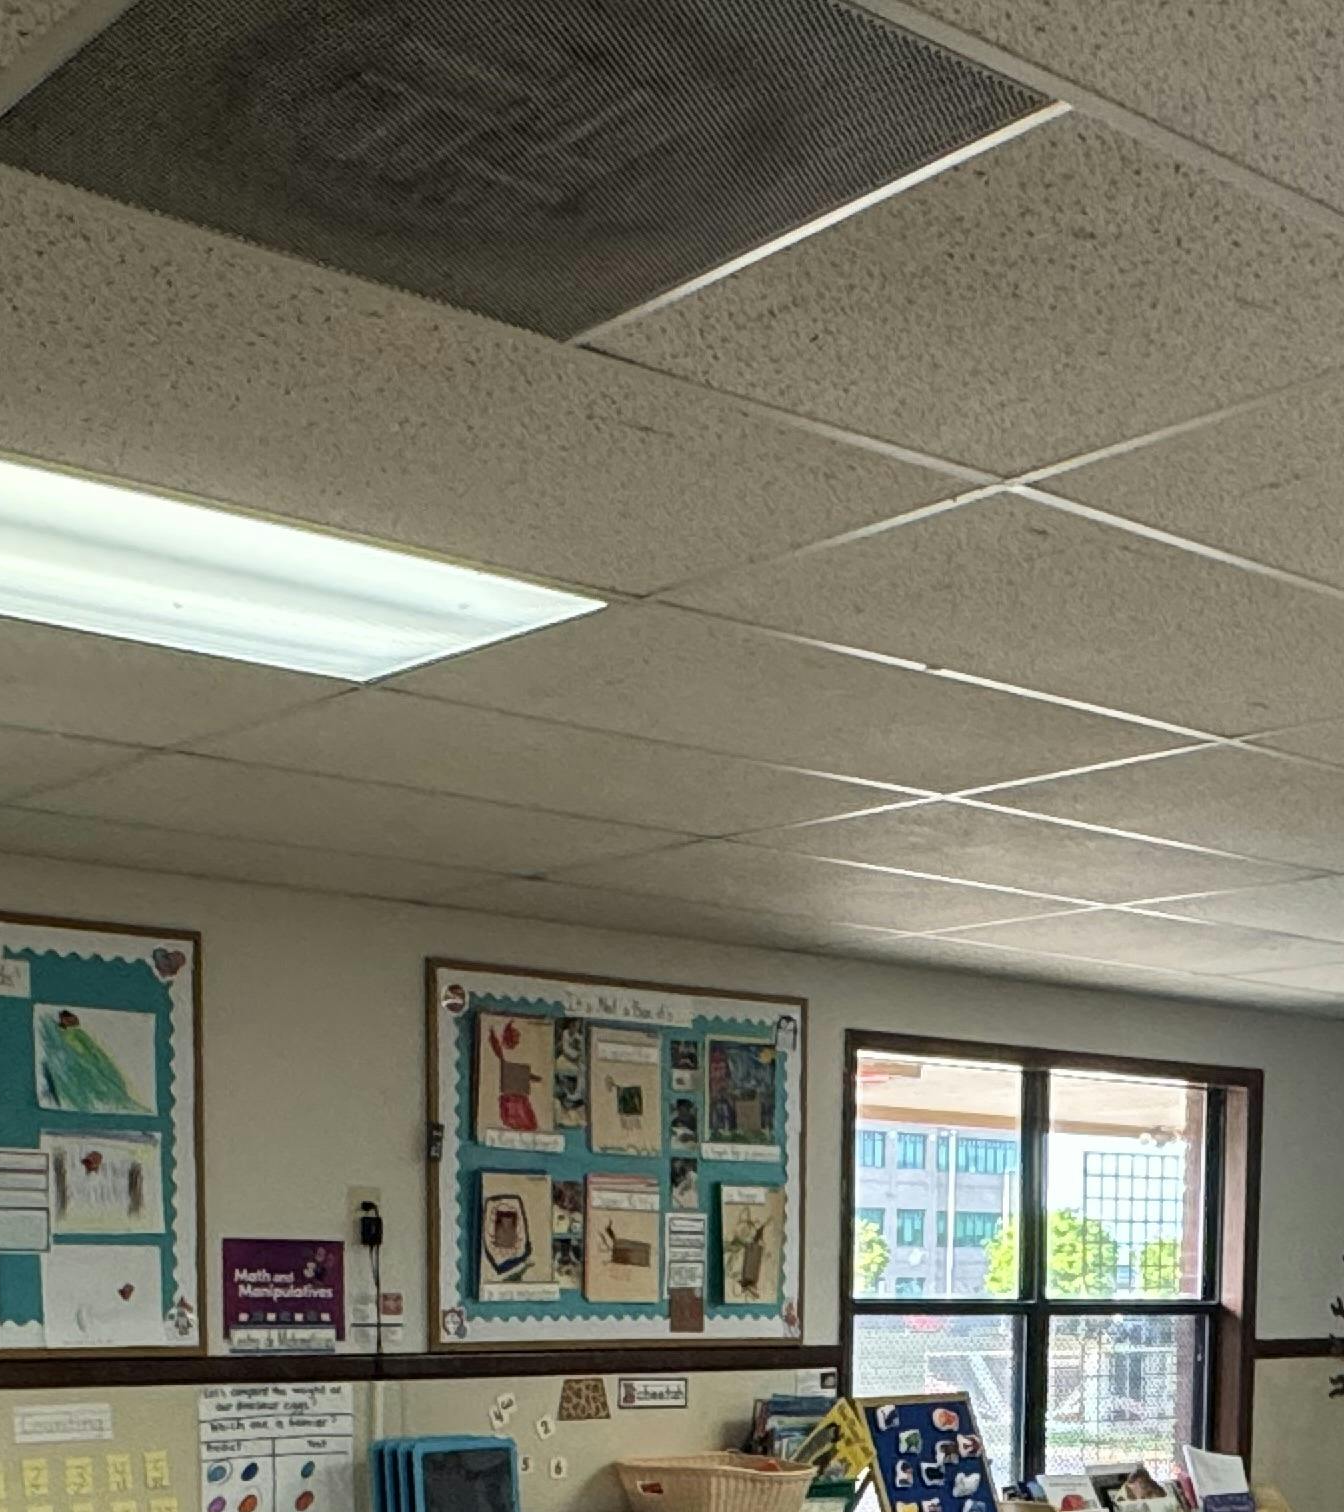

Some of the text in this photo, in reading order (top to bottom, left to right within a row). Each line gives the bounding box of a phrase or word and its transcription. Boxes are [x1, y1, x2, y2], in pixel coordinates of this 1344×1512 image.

[234, 1267, 295, 1283] Math and
[237, 1282, 334, 1303] Manipulatives
